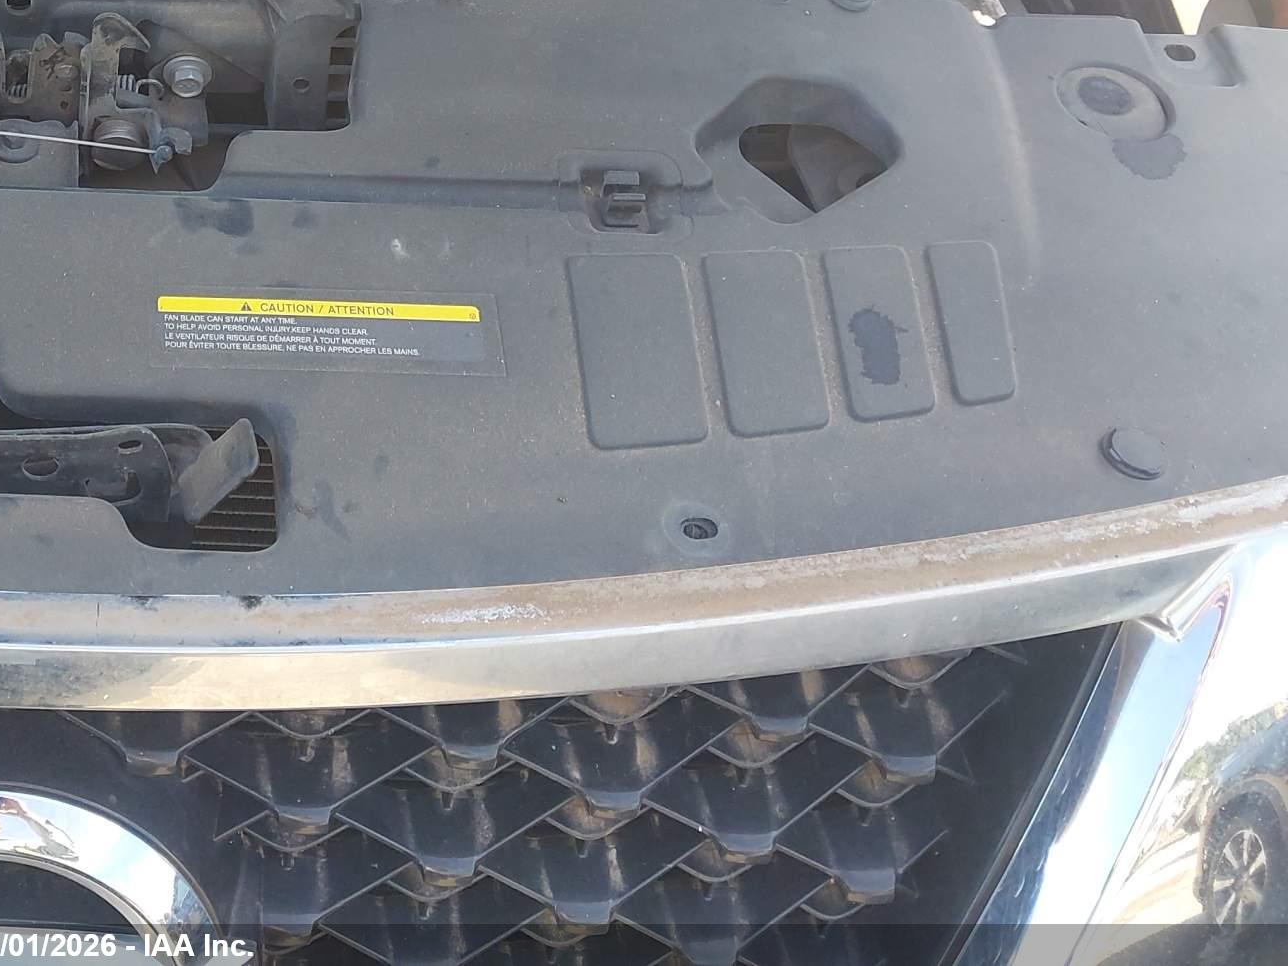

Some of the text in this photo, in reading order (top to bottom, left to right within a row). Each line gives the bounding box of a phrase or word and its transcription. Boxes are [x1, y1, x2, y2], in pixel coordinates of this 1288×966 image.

[260, 302, 314, 313] CAUTION
[328, 305, 394, 316] ATTENTION
[180, 314, 205, 322] BLADE
[206, 315, 224, 323] CAN
[261, 316, 276, 324] ANY
[222, 324, 263, 332] PERSONAL
[312, 326, 340, 334] HANDS
[175, 333, 225, 341] VENTILATEUR
[226, 334, 256, 342] RISQUE
[269, 334, 311, 343] DÉMARRER
[189, 340, 214, 349] ÉVITER
[217, 342, 242, 350] TOUTE
[286, 344, 297, 352] NE
[298, 344, 314, 352] PAS
[315, 345, 326, 353] EN
[328, 346, 378, 354] APPROCHER
